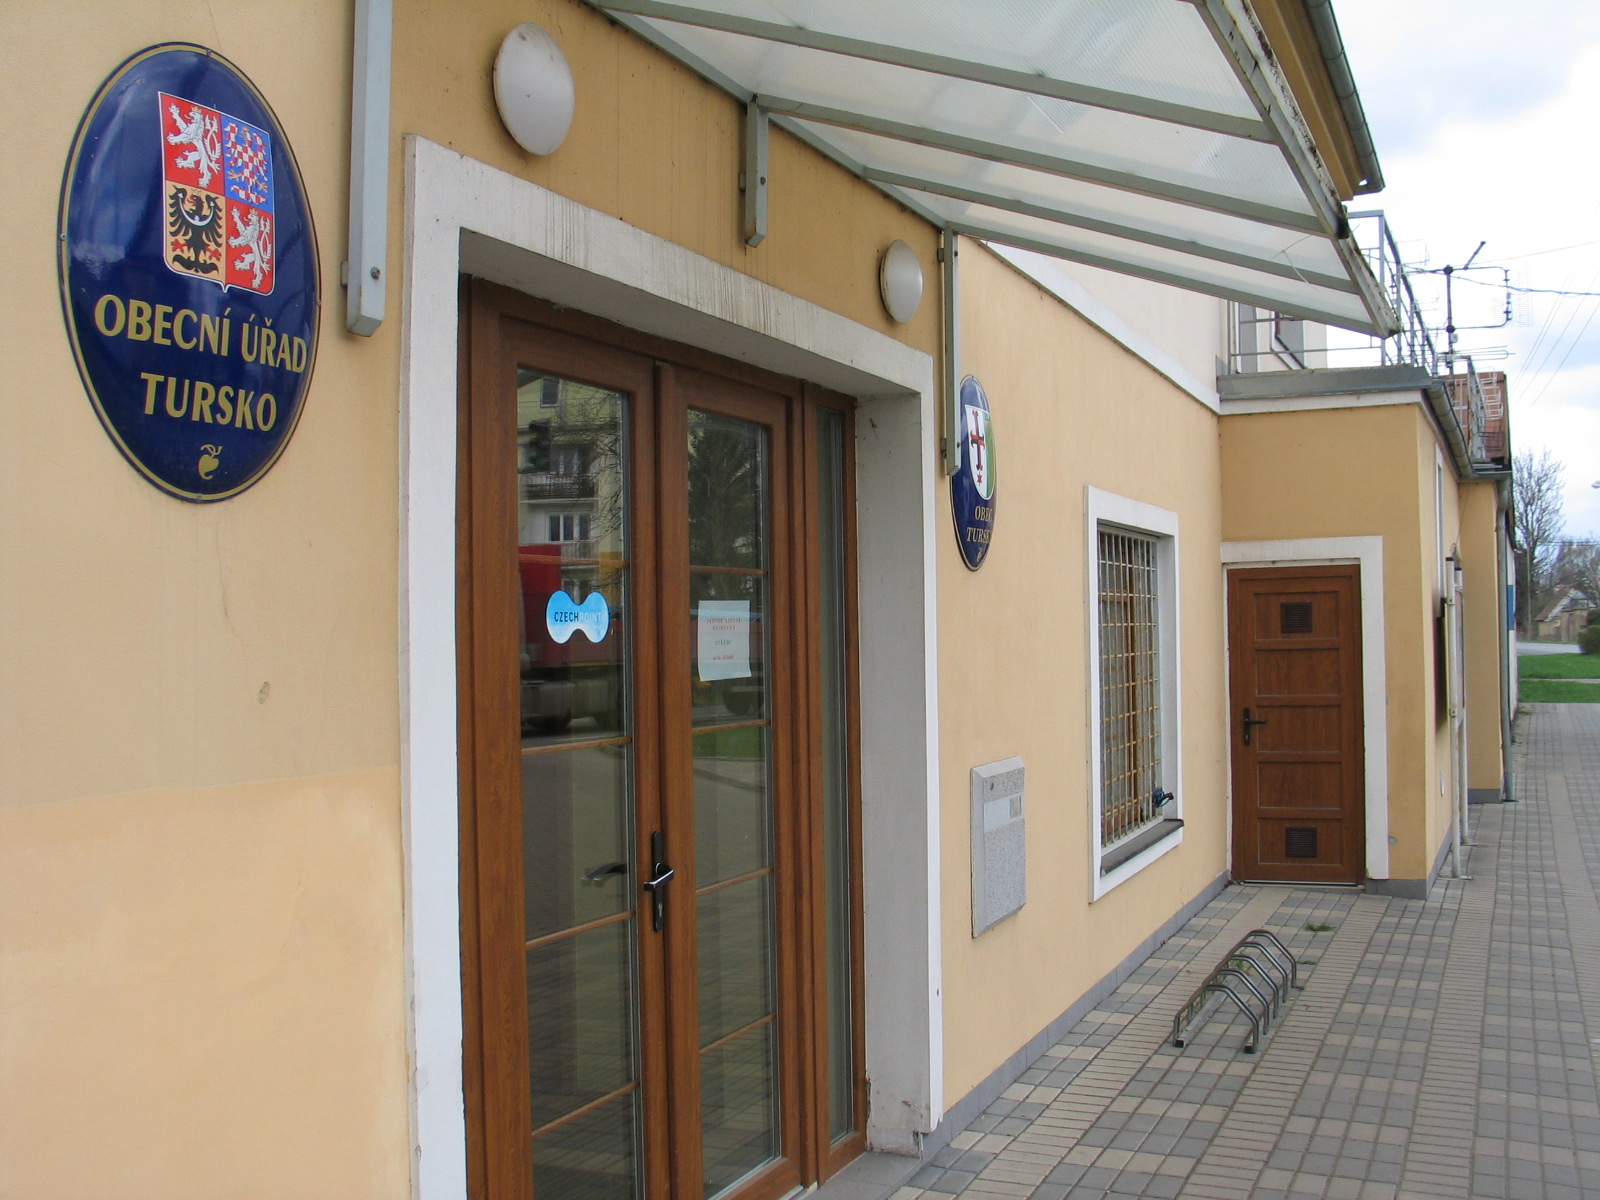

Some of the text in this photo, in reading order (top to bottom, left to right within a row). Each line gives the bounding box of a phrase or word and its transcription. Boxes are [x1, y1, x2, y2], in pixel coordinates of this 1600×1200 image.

[94, 294, 307, 373] OBECNÍ ÚŘAD
[140, 372, 277, 432] TURSKO
